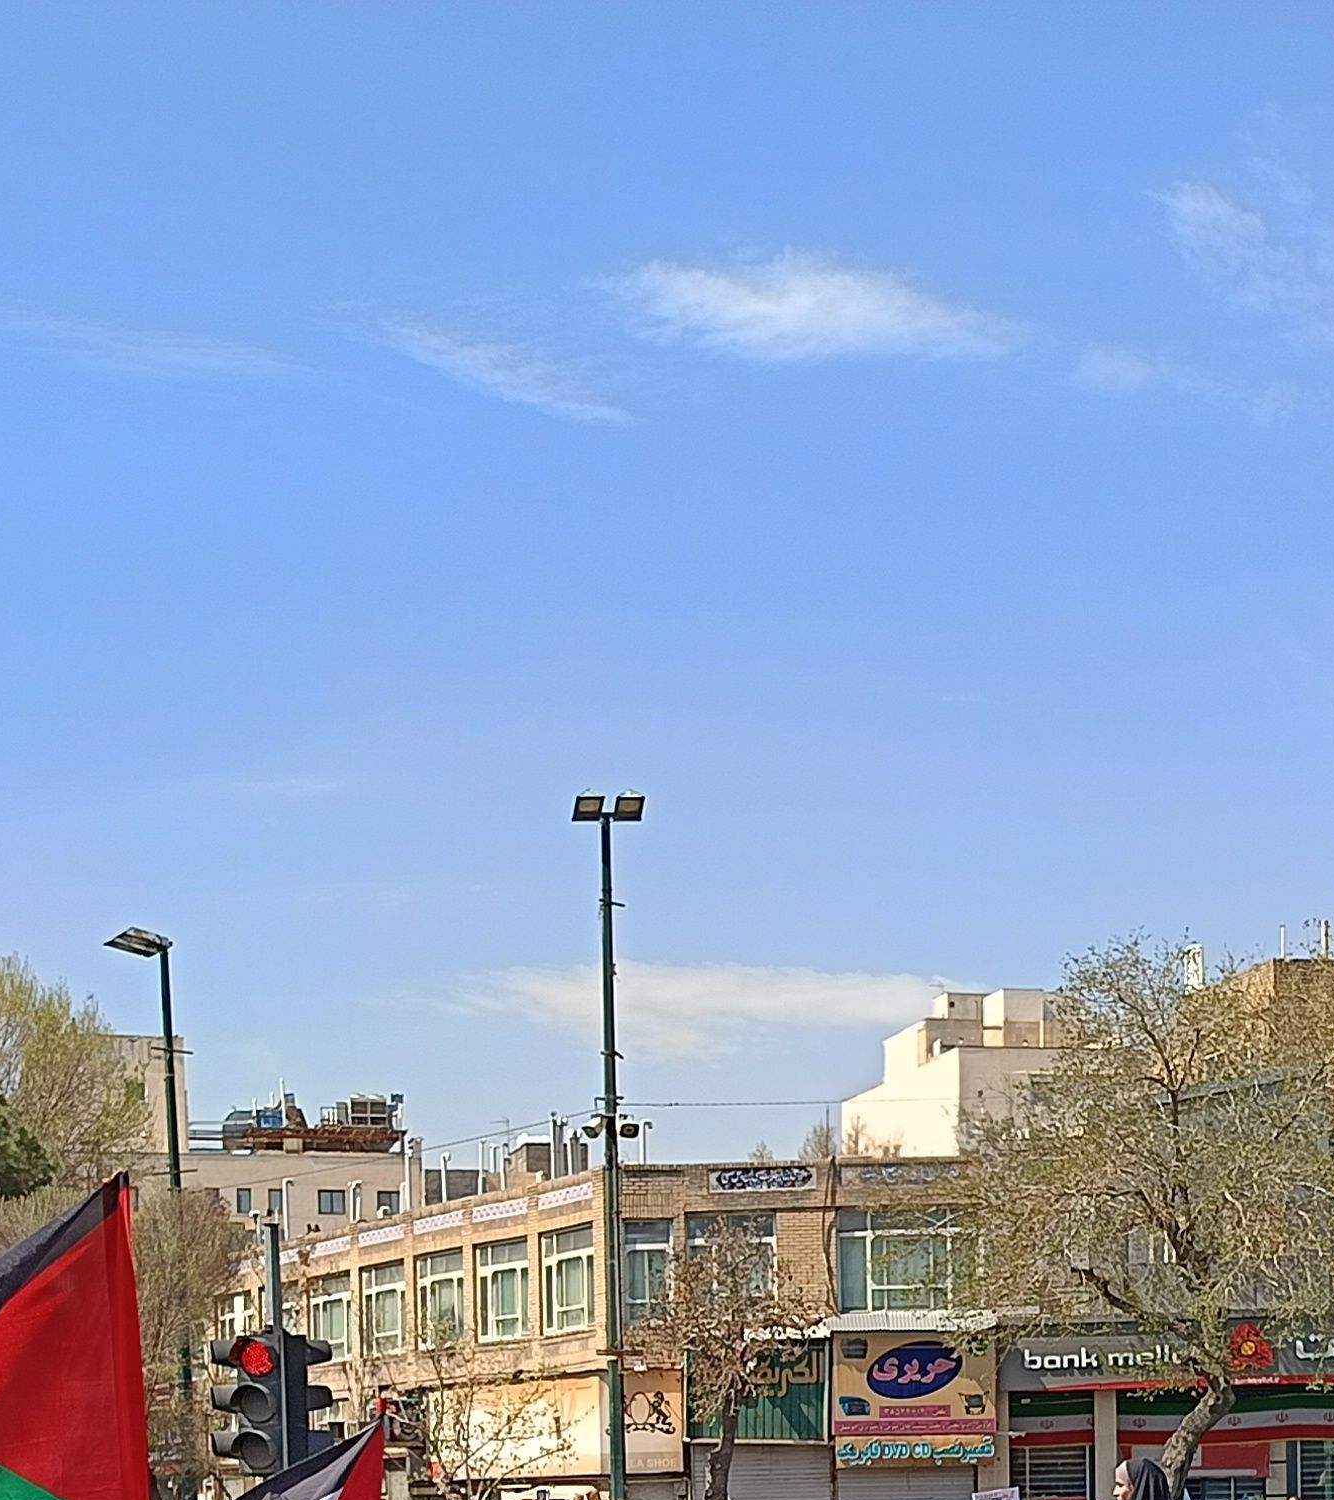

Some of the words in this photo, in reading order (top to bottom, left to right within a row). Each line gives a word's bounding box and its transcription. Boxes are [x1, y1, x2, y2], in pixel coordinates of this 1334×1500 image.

[1023, 1347, 1098, 1370] bank
[1107, 1344, 1183, 1367] mell
[872, 1354, 957, 1384] حریری
[881, 1441, 909, 1458] DVD
[912, 1441, 932, 1458] CD
